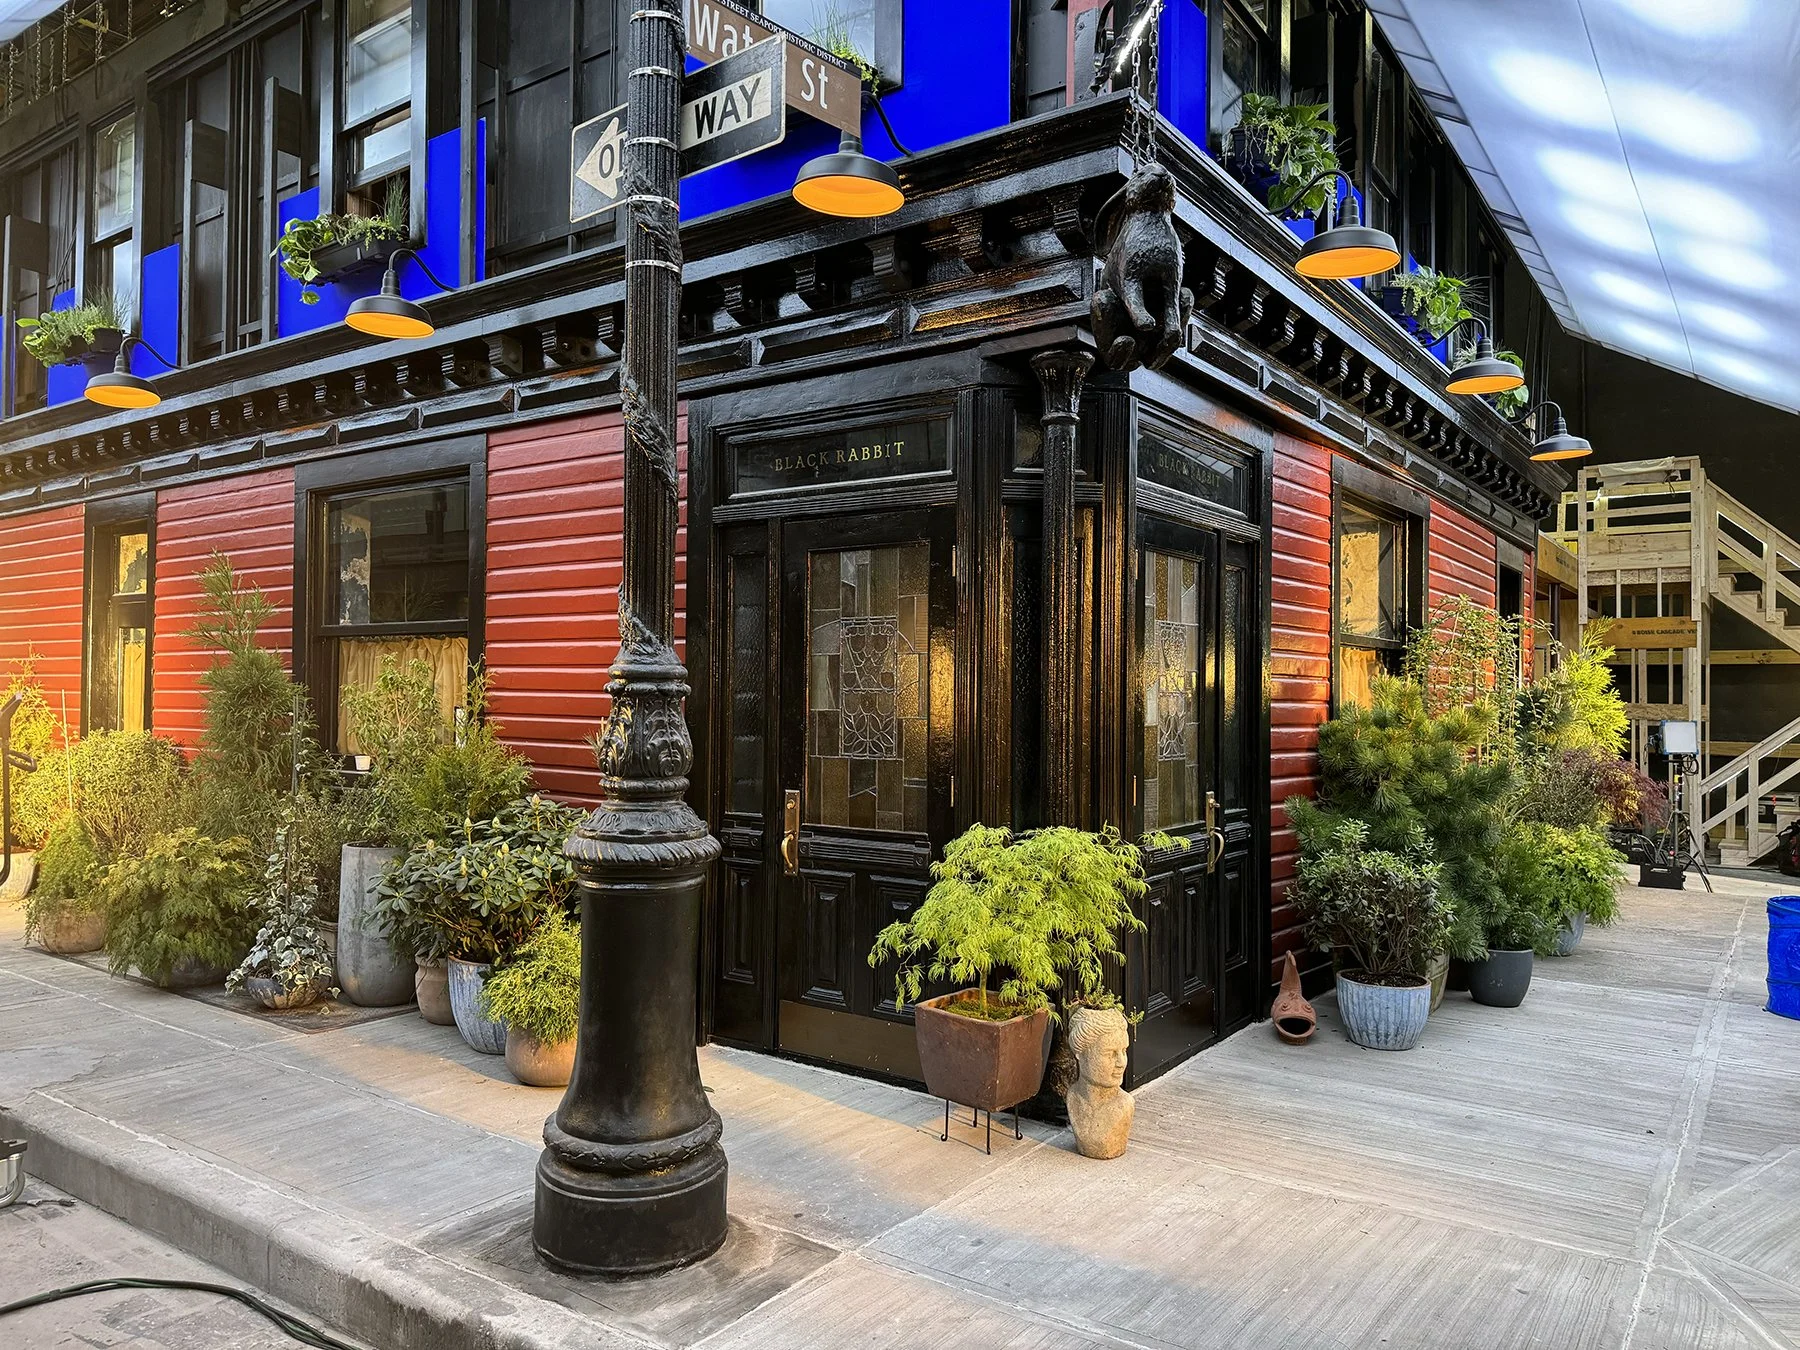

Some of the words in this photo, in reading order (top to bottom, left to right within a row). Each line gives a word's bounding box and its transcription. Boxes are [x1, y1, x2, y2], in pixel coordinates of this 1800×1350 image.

[693, 0, 753, 57] Wat
[800, 58, 829, 110] St
[721, 0, 750, 18] STREET
[783, 31, 816, 54] HISTORIC
[816, 49, 848, 70] DISTRICT
[694, 76, 762, 139] WAY
[774, 451, 829, 471] BLACK
[836, 441, 905, 463] RABBIT
[1159, 453, 1188, 476] BLACK
